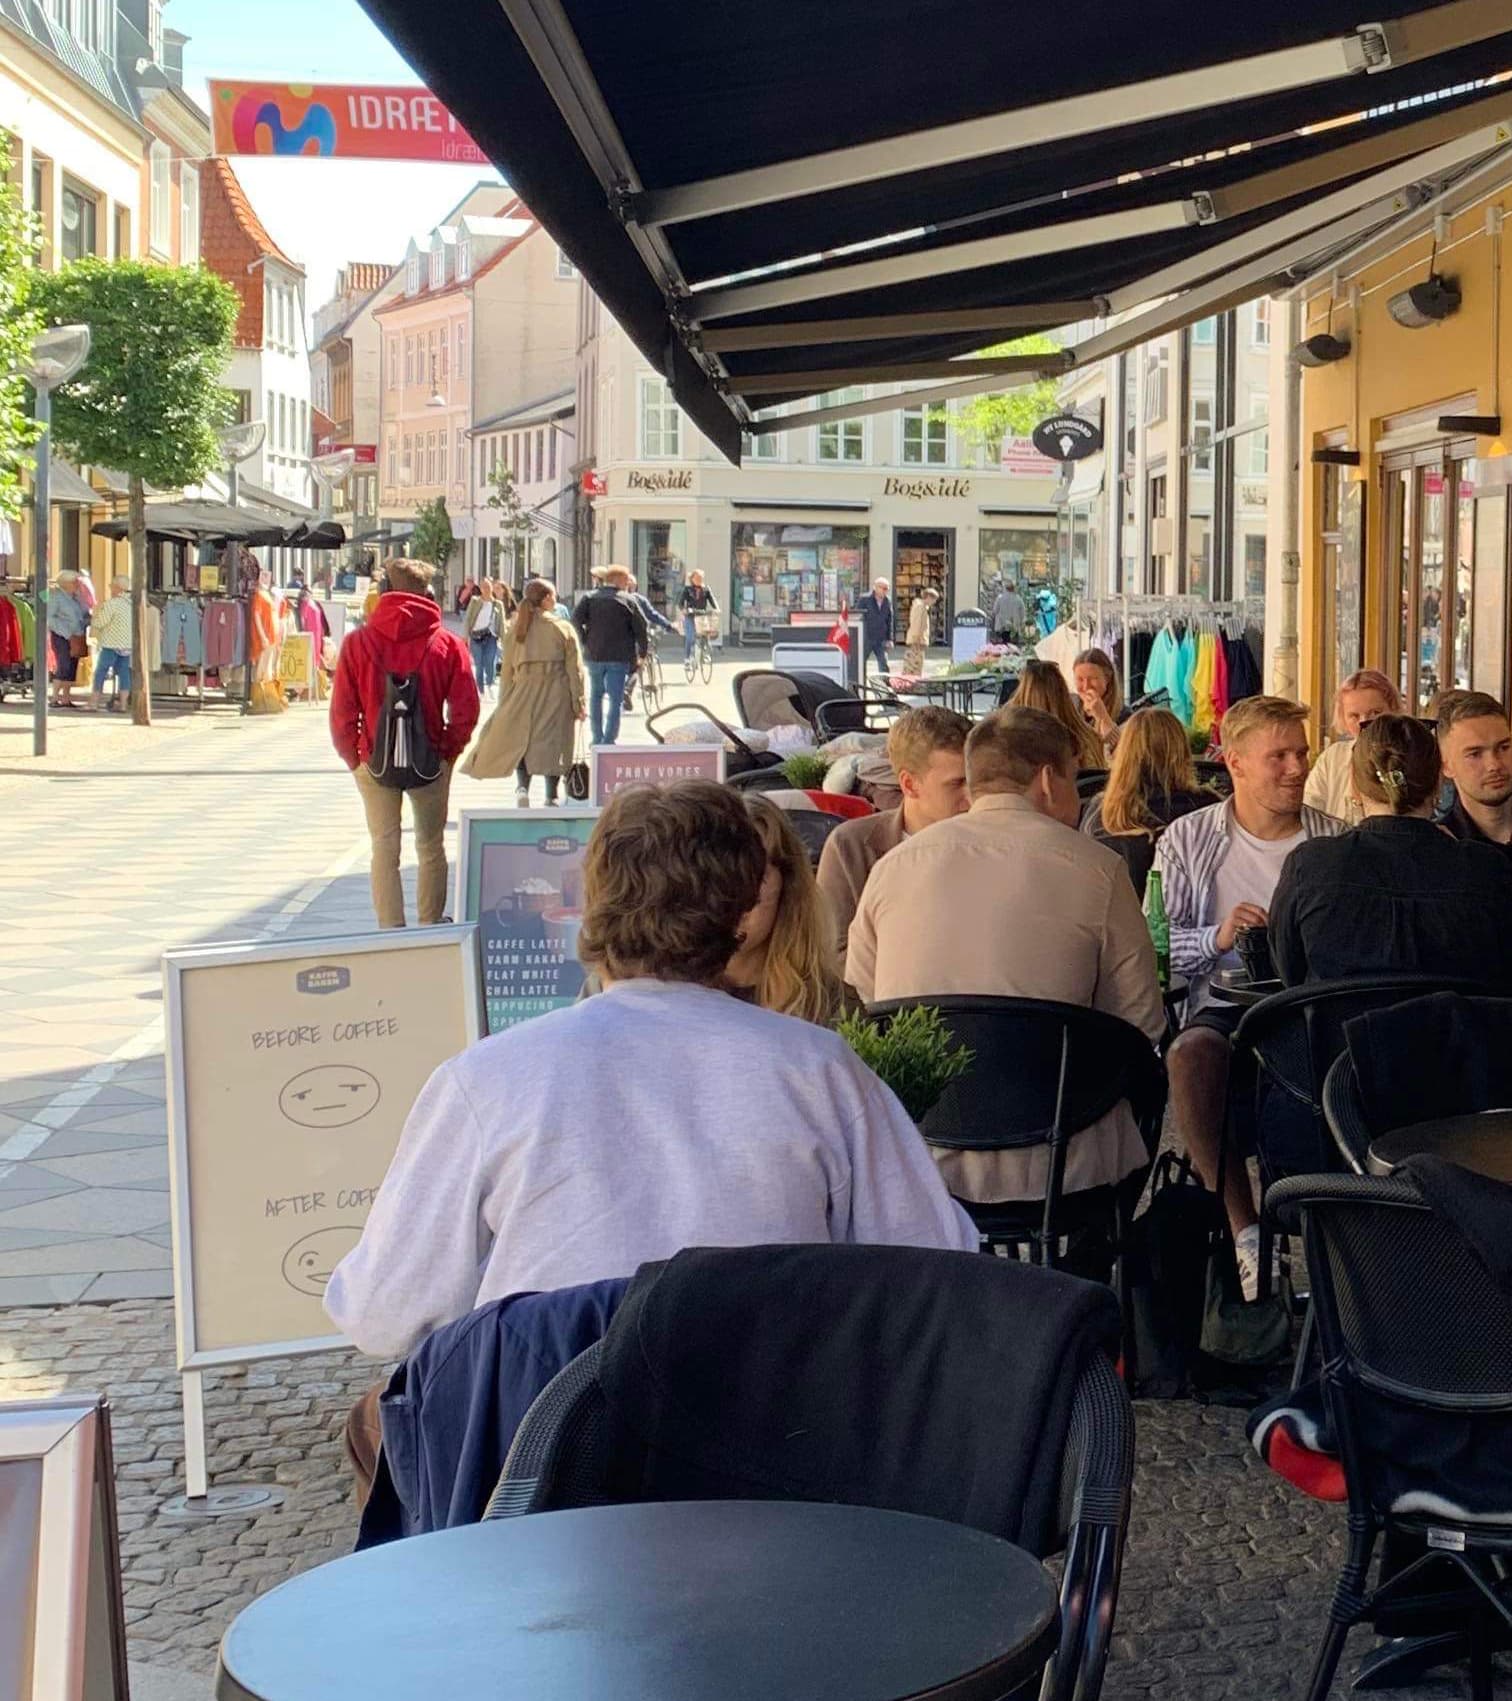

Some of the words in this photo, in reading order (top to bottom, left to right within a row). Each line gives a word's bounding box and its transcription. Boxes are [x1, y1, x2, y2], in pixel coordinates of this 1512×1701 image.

[627, 470, 692, 492] Bog&idé
[883, 477, 970, 500] Bog&idé
[531, 938, 566, 949] LATTE
[526, 953, 565, 964] KAKAO
[486, 970, 516, 981] FLAT
[522, 969, 560, 980] WHITE
[520, 984, 558, 996] LATTE
[251, 1024, 322, 1051] BEFORE
[332, 1016, 401, 1043] COFFEE
[264, 1190, 327, 1218] AFTER
